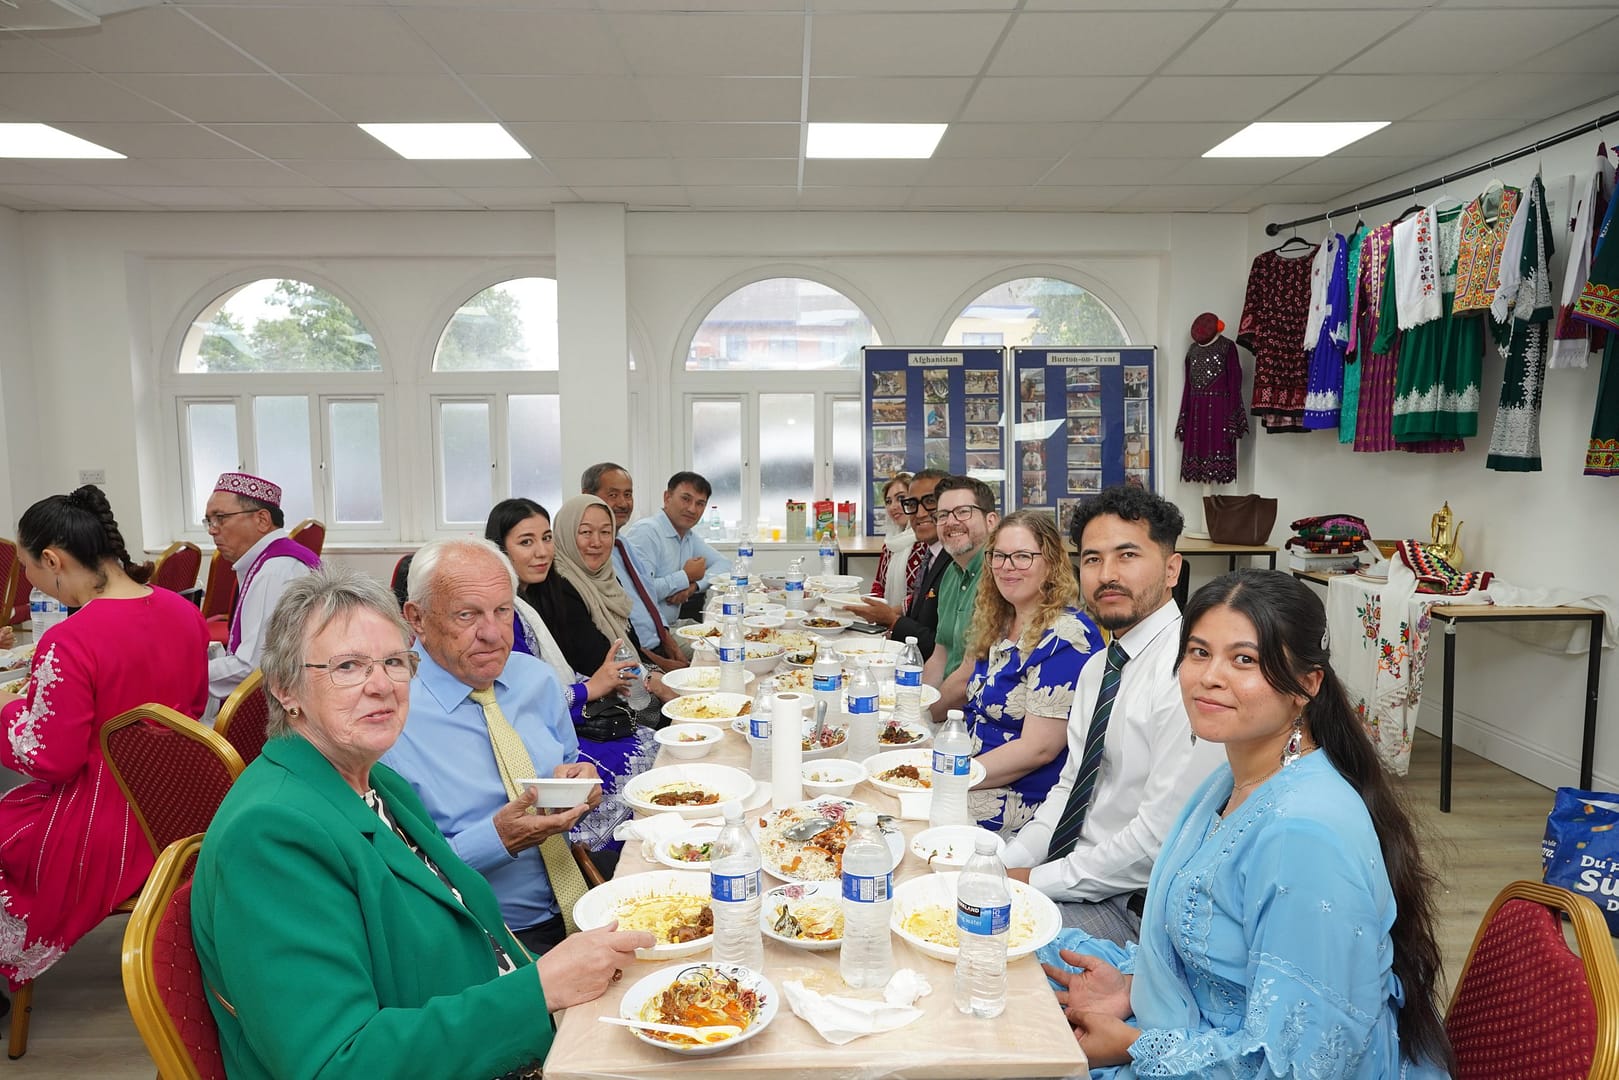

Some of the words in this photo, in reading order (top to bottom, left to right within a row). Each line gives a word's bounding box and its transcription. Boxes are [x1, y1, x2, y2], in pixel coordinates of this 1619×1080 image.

[912, 355, 958, 364] Afghanistan
[1051, 355, 1116, 363] Burton-on-Trent
[1580, 854, 1607, 869] Du
